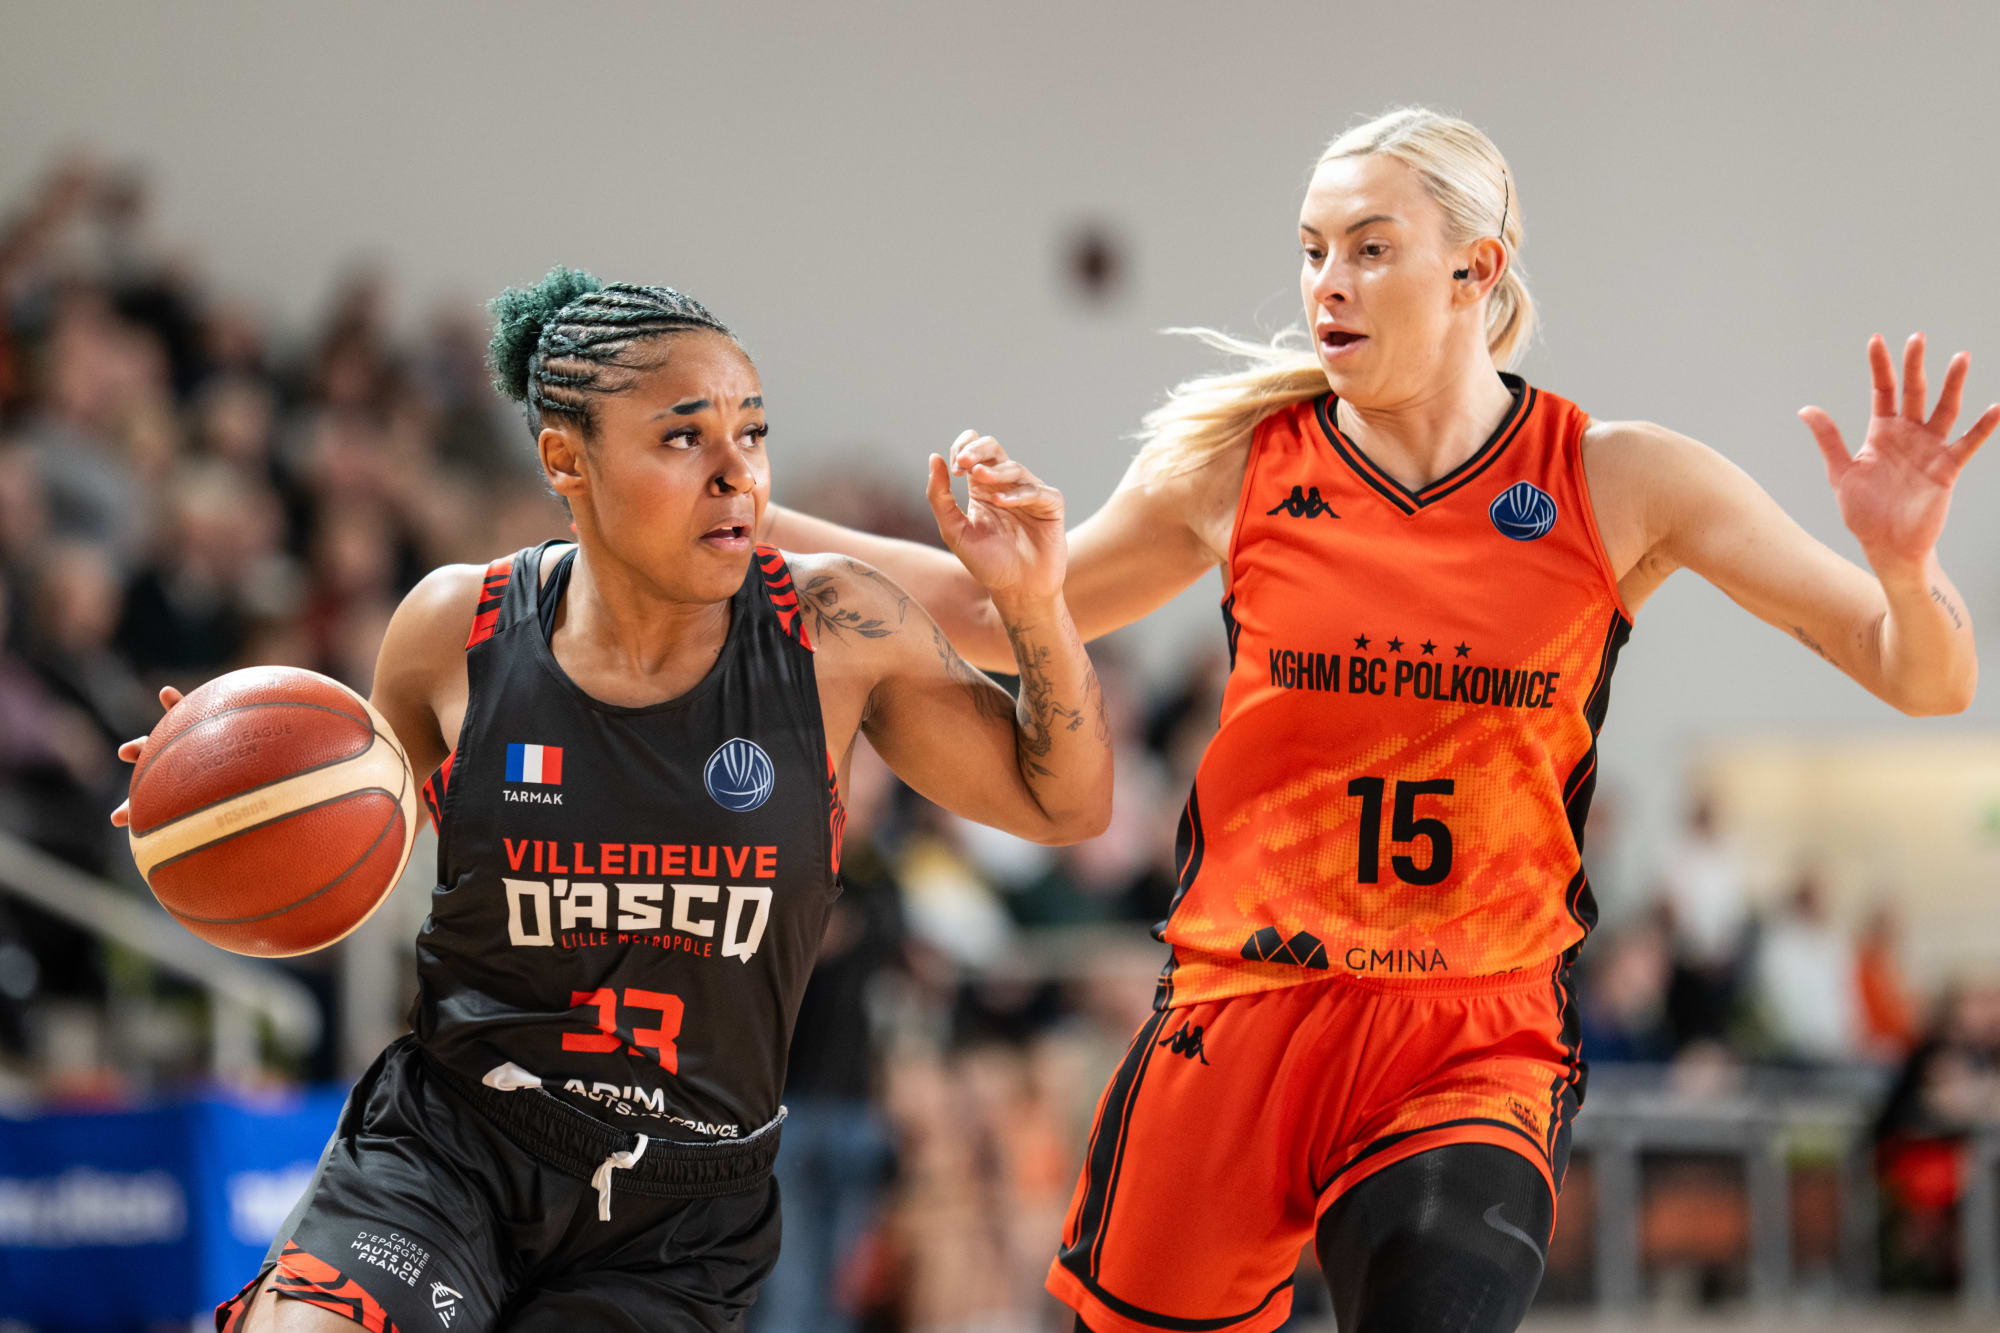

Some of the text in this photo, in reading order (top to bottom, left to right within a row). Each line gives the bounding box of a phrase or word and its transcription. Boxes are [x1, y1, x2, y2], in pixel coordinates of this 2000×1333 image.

[1269, 648, 1560, 708] KGHM BC POLKOWICE
[503, 790, 564, 805] TARMAK
[1347, 776, 1455, 886] 15
[502, 838, 777, 878] VILLENEUVE
[501, 878, 774, 964] D'ASCQ
[562, 932, 609, 949] LILLE
[1345, 947, 1448, 973] GMINA
[561, 987, 685, 1076] 33
[350, 1240, 421, 1278] HAUTS DE
[357, 1232, 427, 1269] D'EPARGNE
[390, 1233, 430, 1262] CAISSE
[358, 1252, 417, 1287] FRANCE
